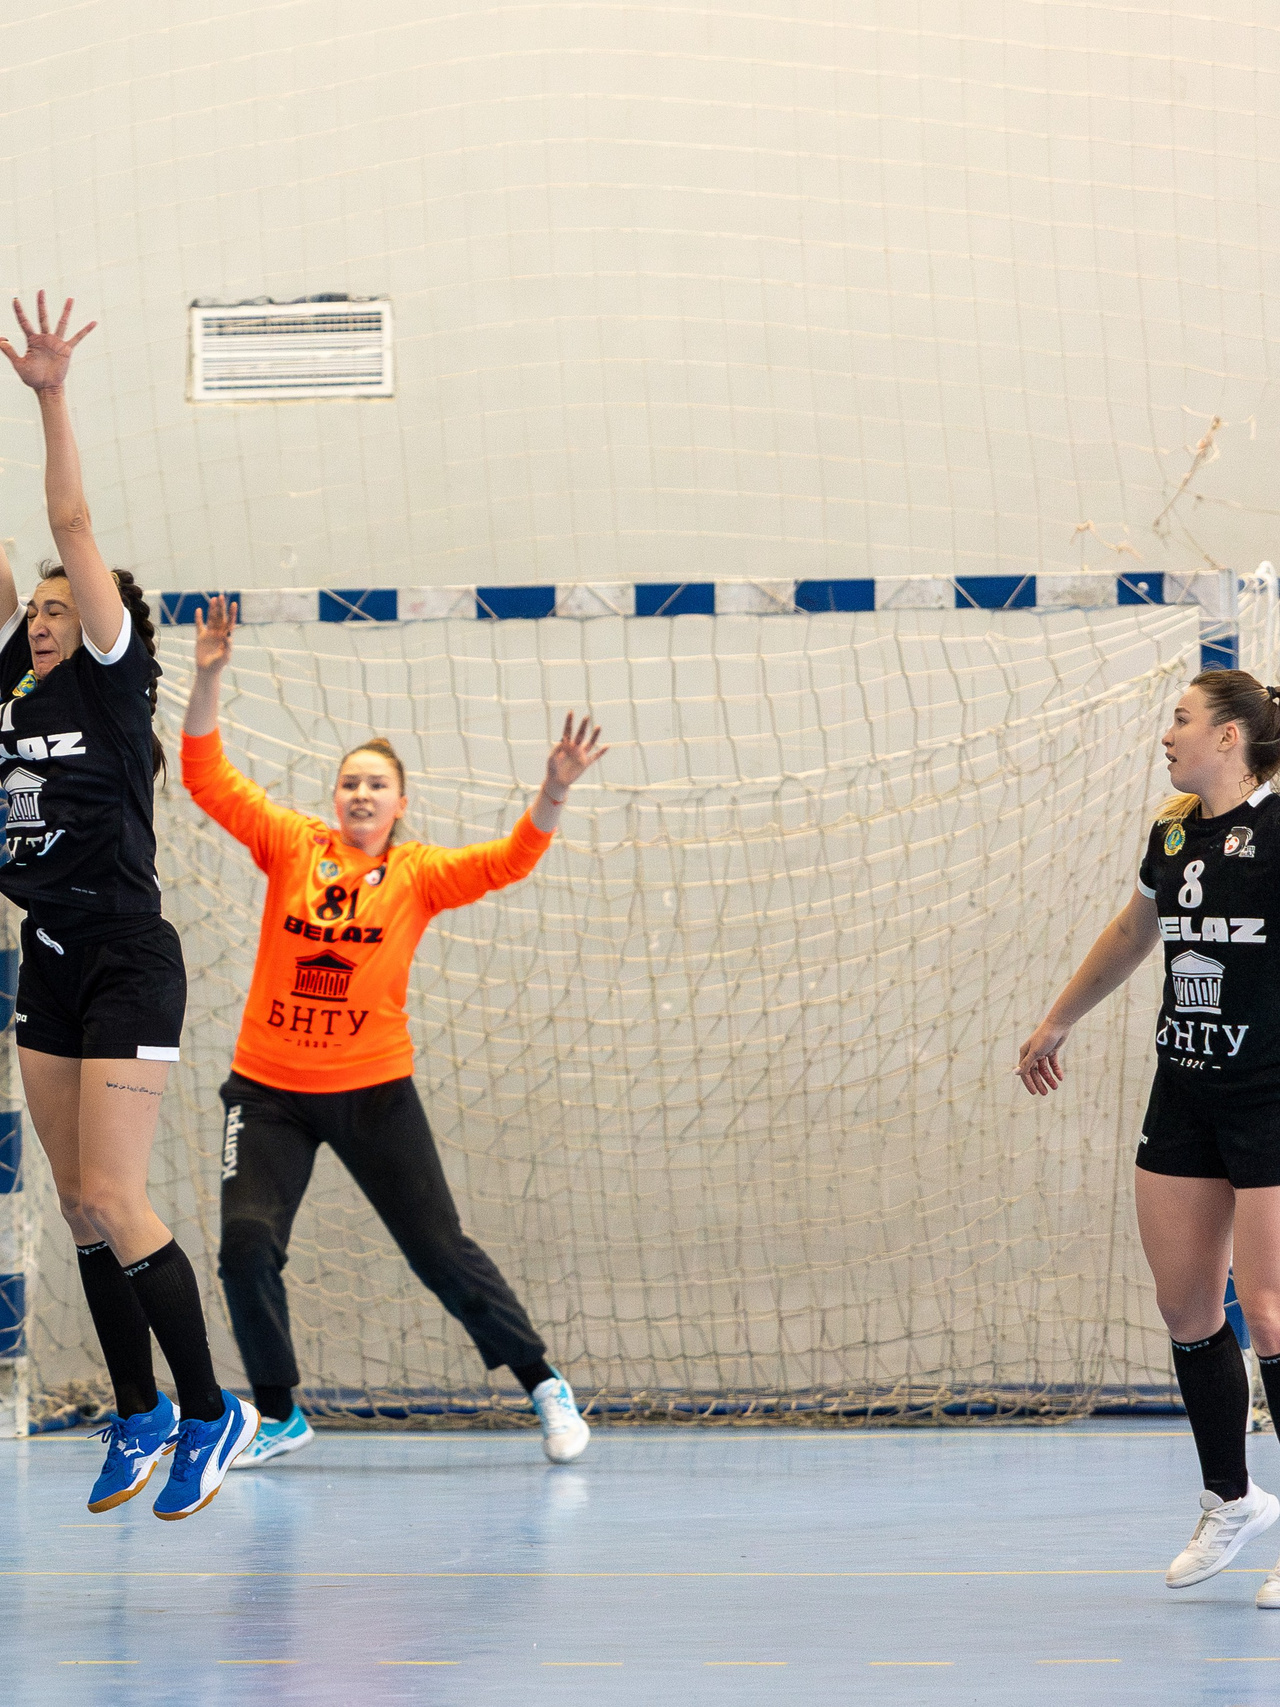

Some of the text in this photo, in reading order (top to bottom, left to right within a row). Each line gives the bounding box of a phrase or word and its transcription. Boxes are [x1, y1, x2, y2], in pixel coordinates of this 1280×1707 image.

[1178, 859, 1206, 909] 8
[316, 885, 360, 921] 81
[283, 915, 384, 944] BELAZ
[1157, 916, 1268, 943] ELAZ
[266, 999, 370, 1037] БНТУ
[222, 1104, 246, 1181] Kempa
